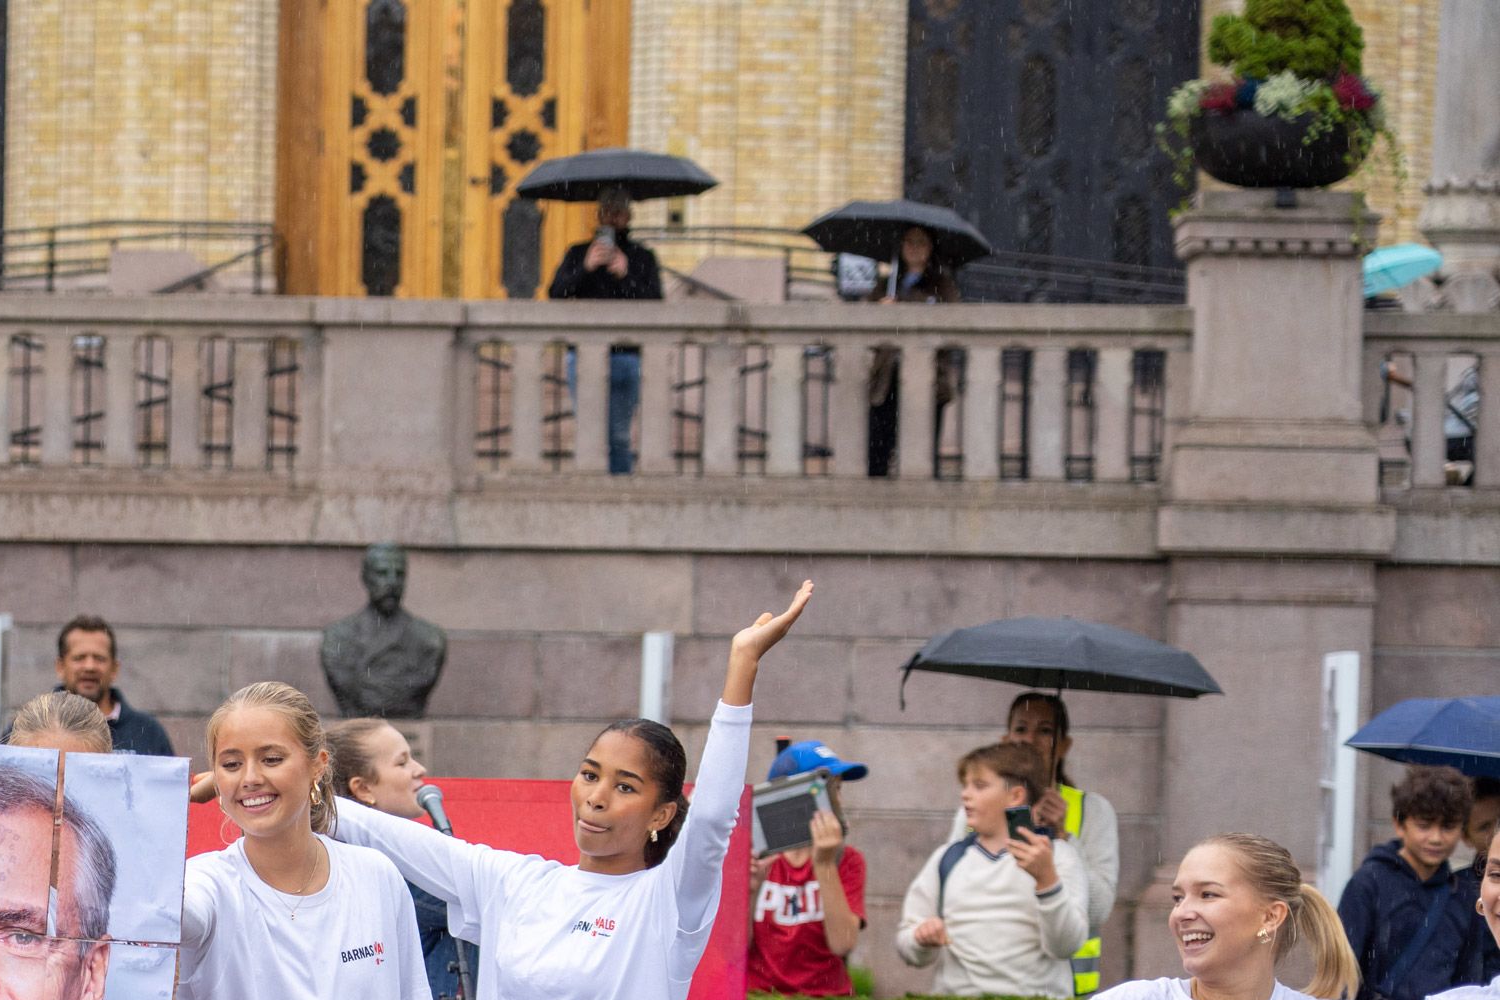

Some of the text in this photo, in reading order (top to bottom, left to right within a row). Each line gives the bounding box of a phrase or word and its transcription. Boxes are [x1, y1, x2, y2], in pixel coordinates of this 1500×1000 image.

[754, 880, 825, 926] POL
[595, 917, 616, 931] VALG
[341, 944, 375, 963] BARNAS
